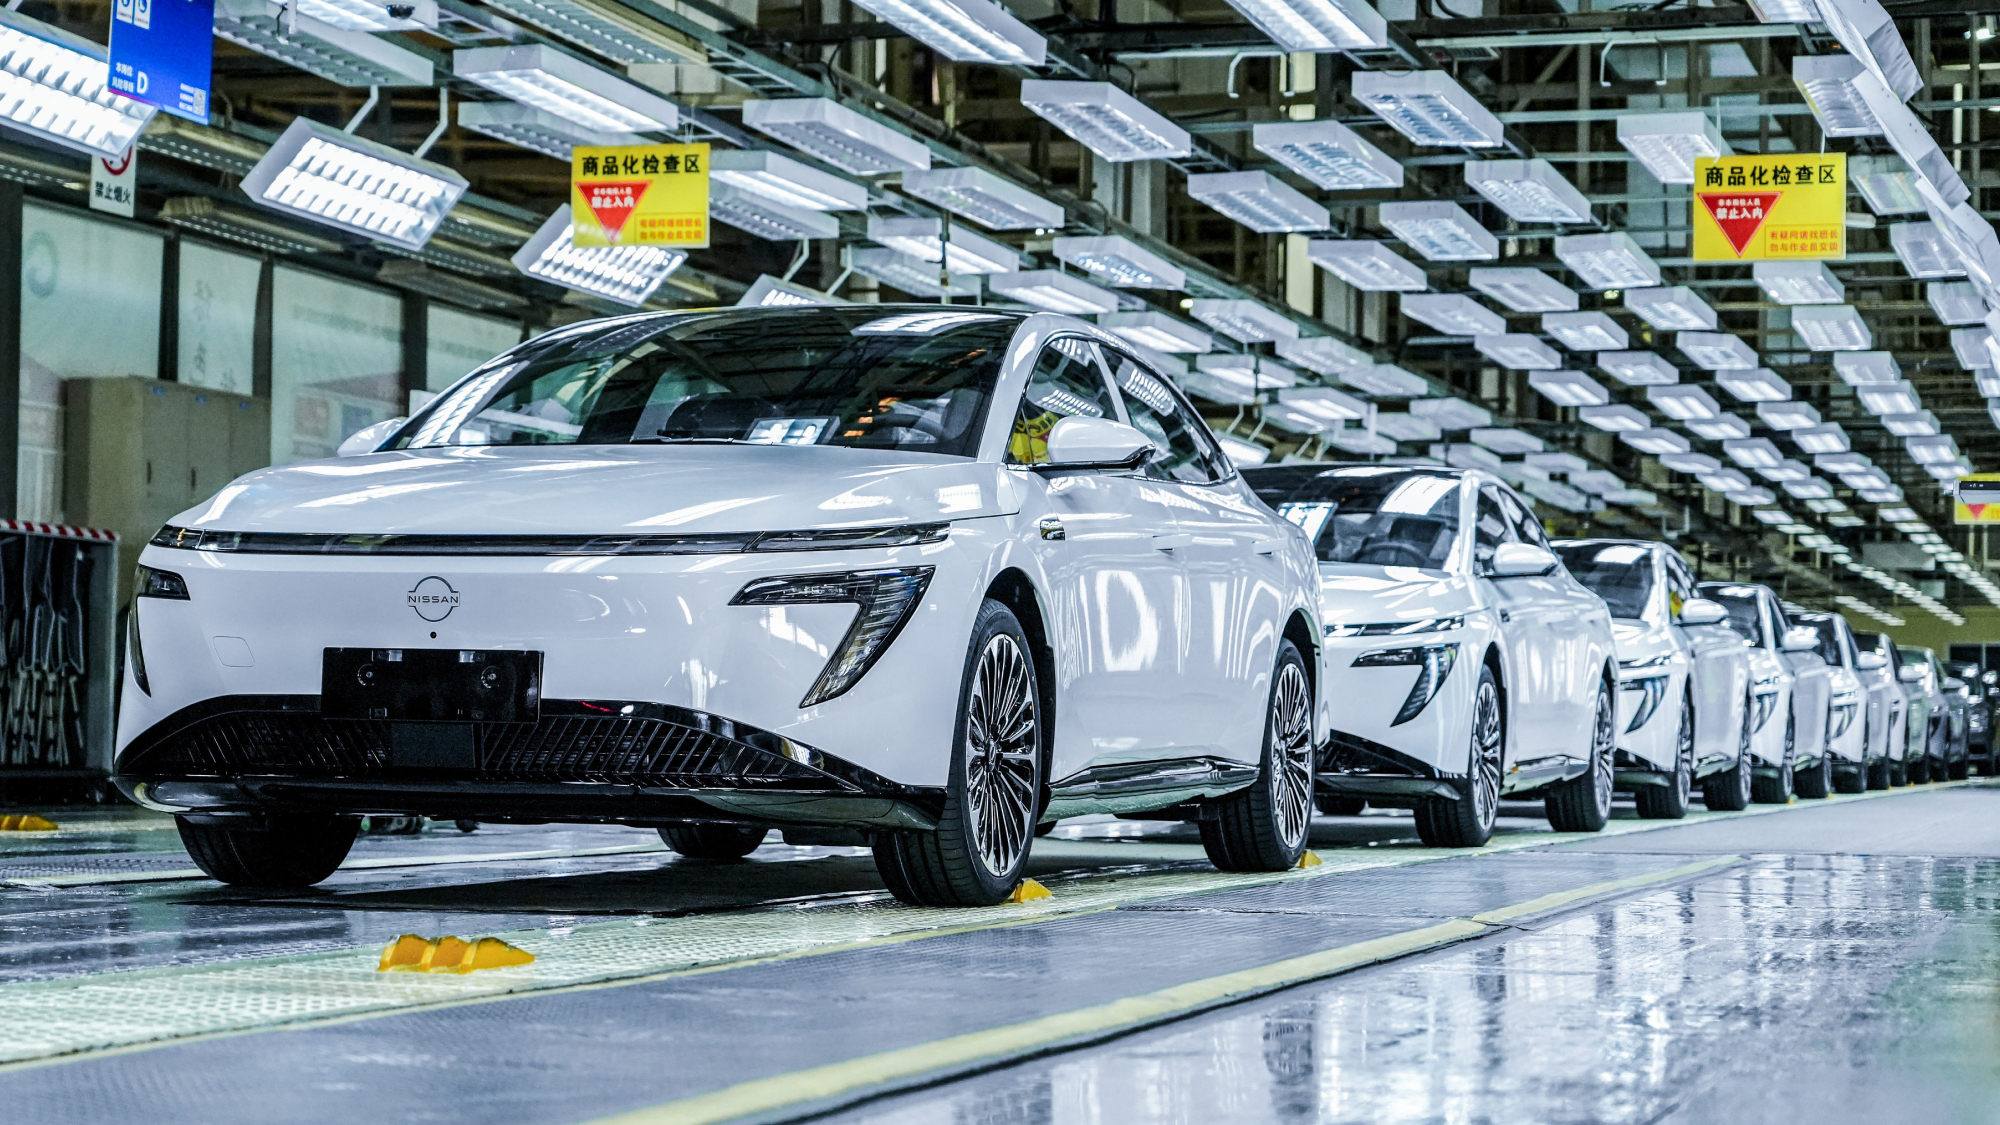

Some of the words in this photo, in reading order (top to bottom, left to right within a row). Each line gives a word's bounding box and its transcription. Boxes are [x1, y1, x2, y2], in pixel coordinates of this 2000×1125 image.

[137, 71, 148, 94] D
[582, 154, 700, 175] 商品化检查区
[1705, 164, 1836, 187] 商品化检查区
[95, 181, 131, 205] 禁止烟火
[592, 196, 634, 208] 禁止入内
[1716, 207, 1763, 219] 禁止入内
